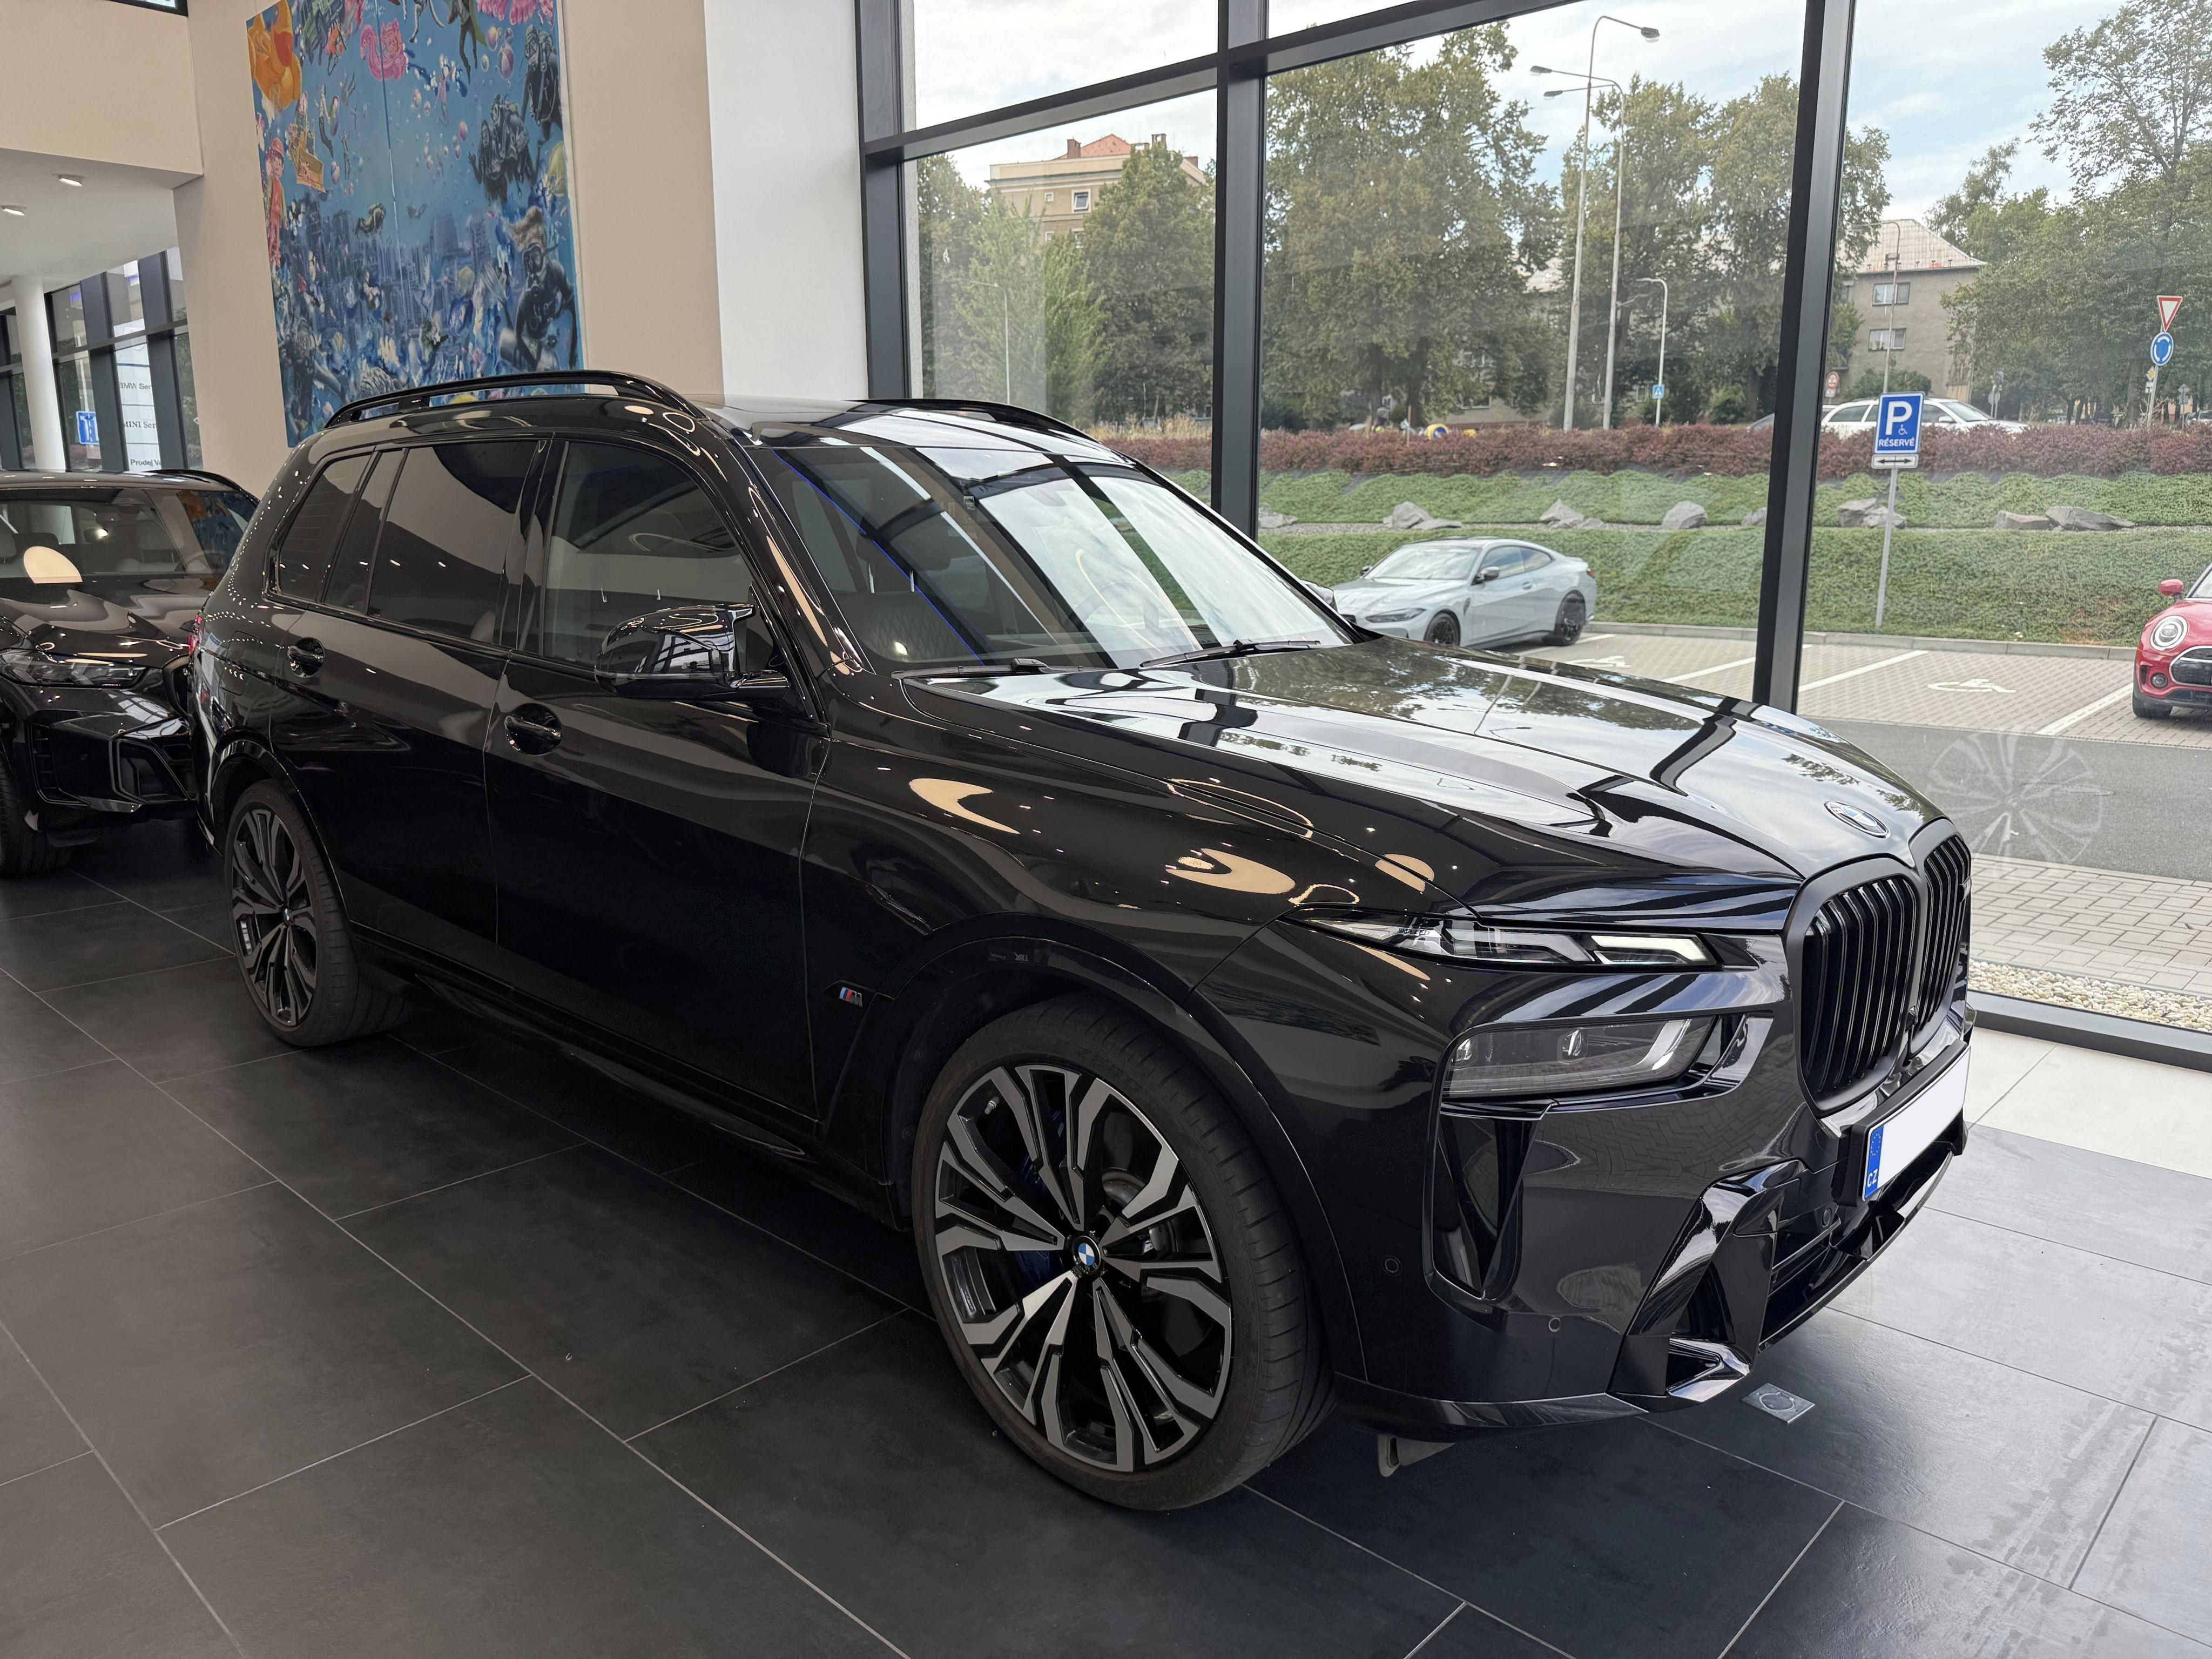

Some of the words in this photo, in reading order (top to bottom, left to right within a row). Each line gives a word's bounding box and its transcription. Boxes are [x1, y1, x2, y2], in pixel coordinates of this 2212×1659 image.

[1885, 401, 1913, 435] P
[1878, 437, 1914, 447] RÉSERVÉ
[1867, 1168, 1878, 1188] CZ
